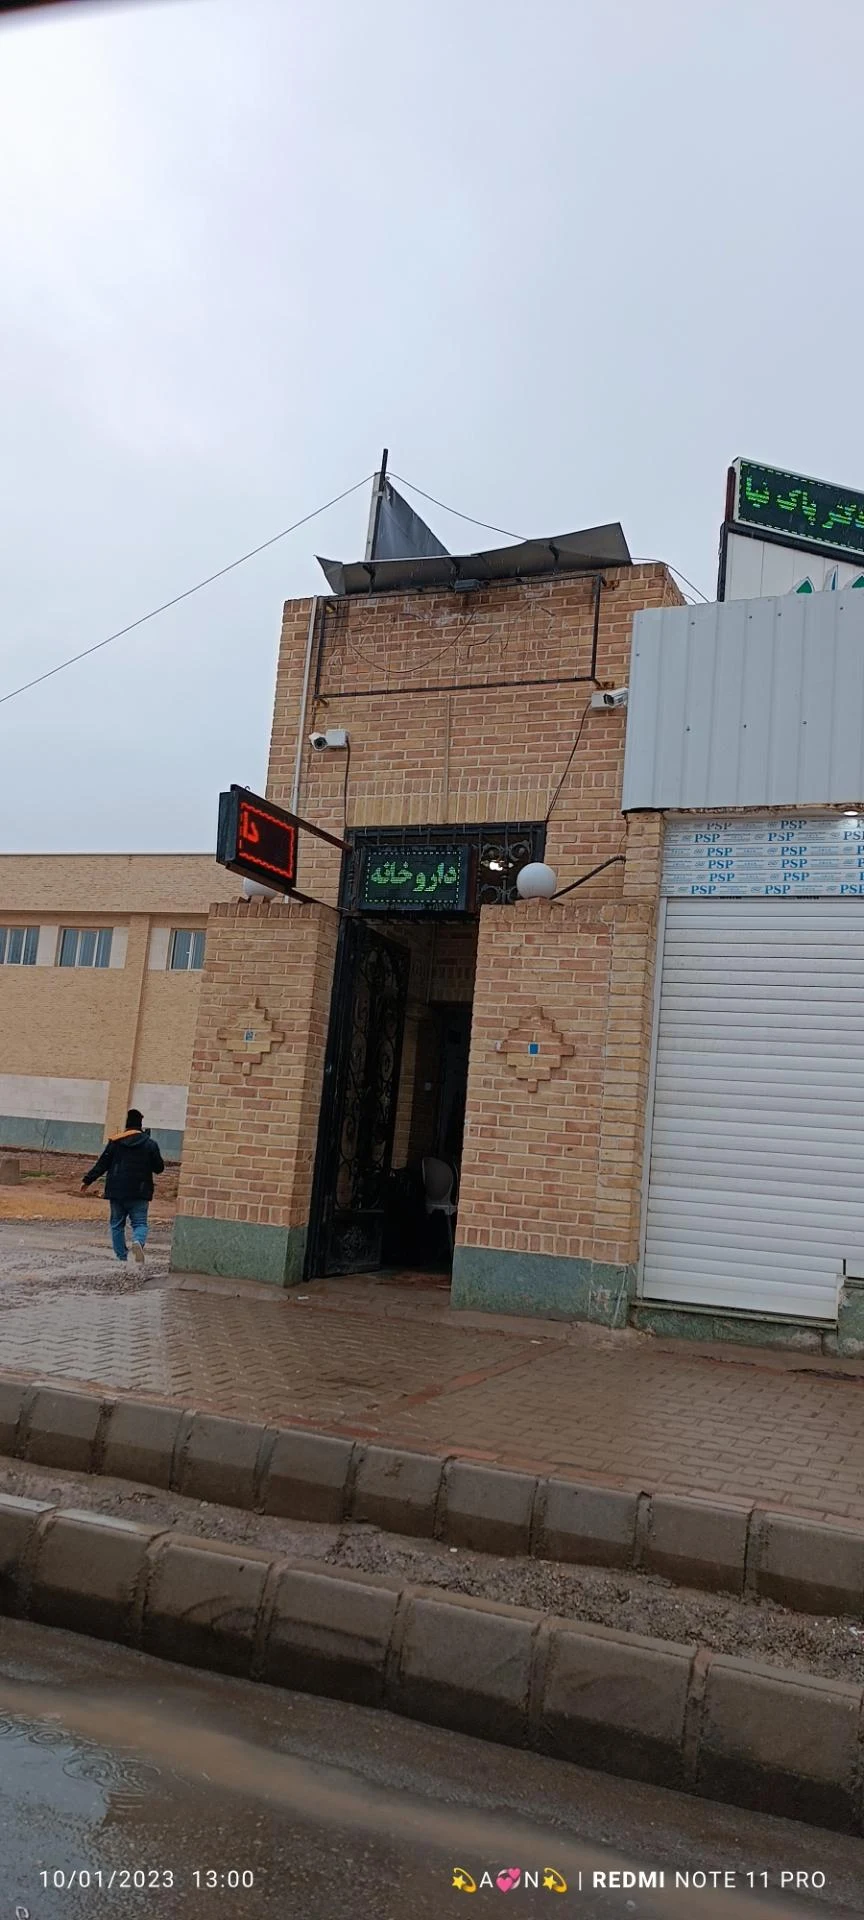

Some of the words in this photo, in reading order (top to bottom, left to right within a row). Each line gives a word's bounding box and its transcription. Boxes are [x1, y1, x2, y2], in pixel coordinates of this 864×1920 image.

[780, 819, 807, 830] PSP
[694, 833, 720, 843] PSP
[768, 832, 794, 842] PSP
[707, 847, 732, 857] PSP
[780, 846, 807, 856] PSP
[708, 859, 734, 869] PSP
[781, 858, 807, 868] PSP
[371, 861, 457, 892] داروخانه
[709, 872, 735, 882] PSP
[783, 871, 810, 881] PSP
[691, 885, 717, 895] PSP
[765, 884, 791, 894] PSP
